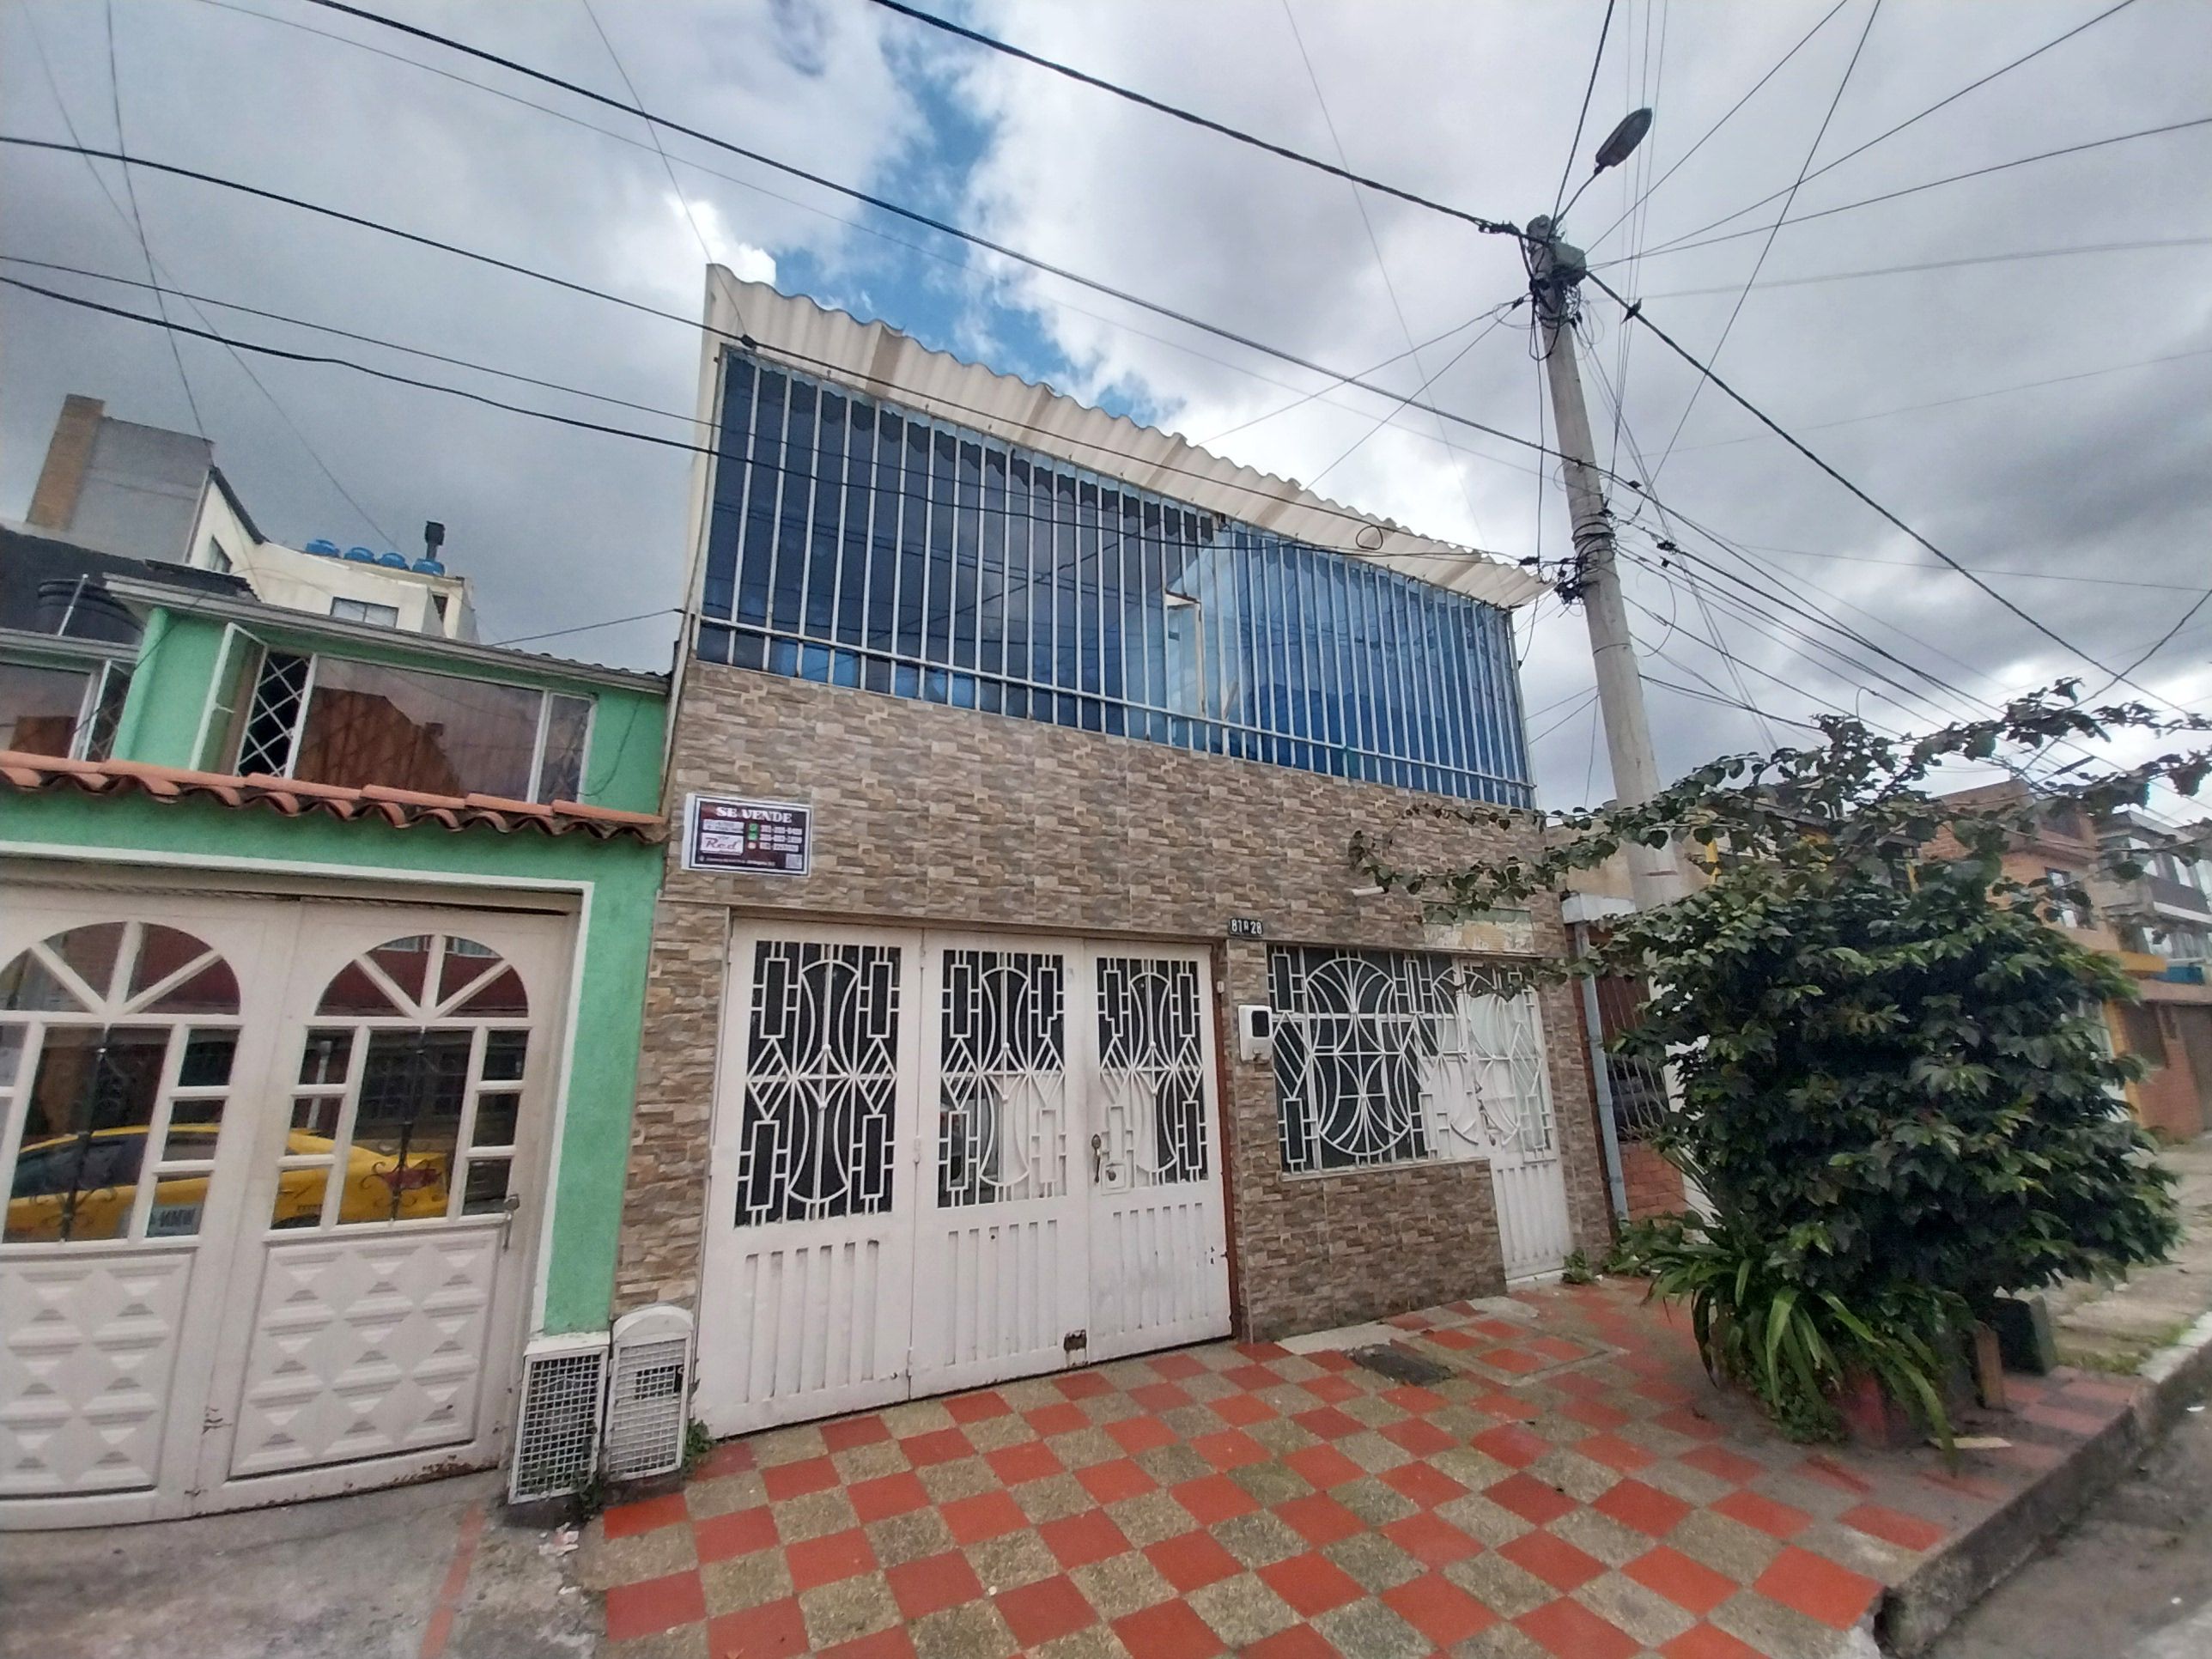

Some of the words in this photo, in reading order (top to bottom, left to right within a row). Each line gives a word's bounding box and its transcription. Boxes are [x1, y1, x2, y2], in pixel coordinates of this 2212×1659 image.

[715, 807, 738, 817] SE
[742, 809, 792, 823] VENDE
[705, 836, 738, 850] Red
